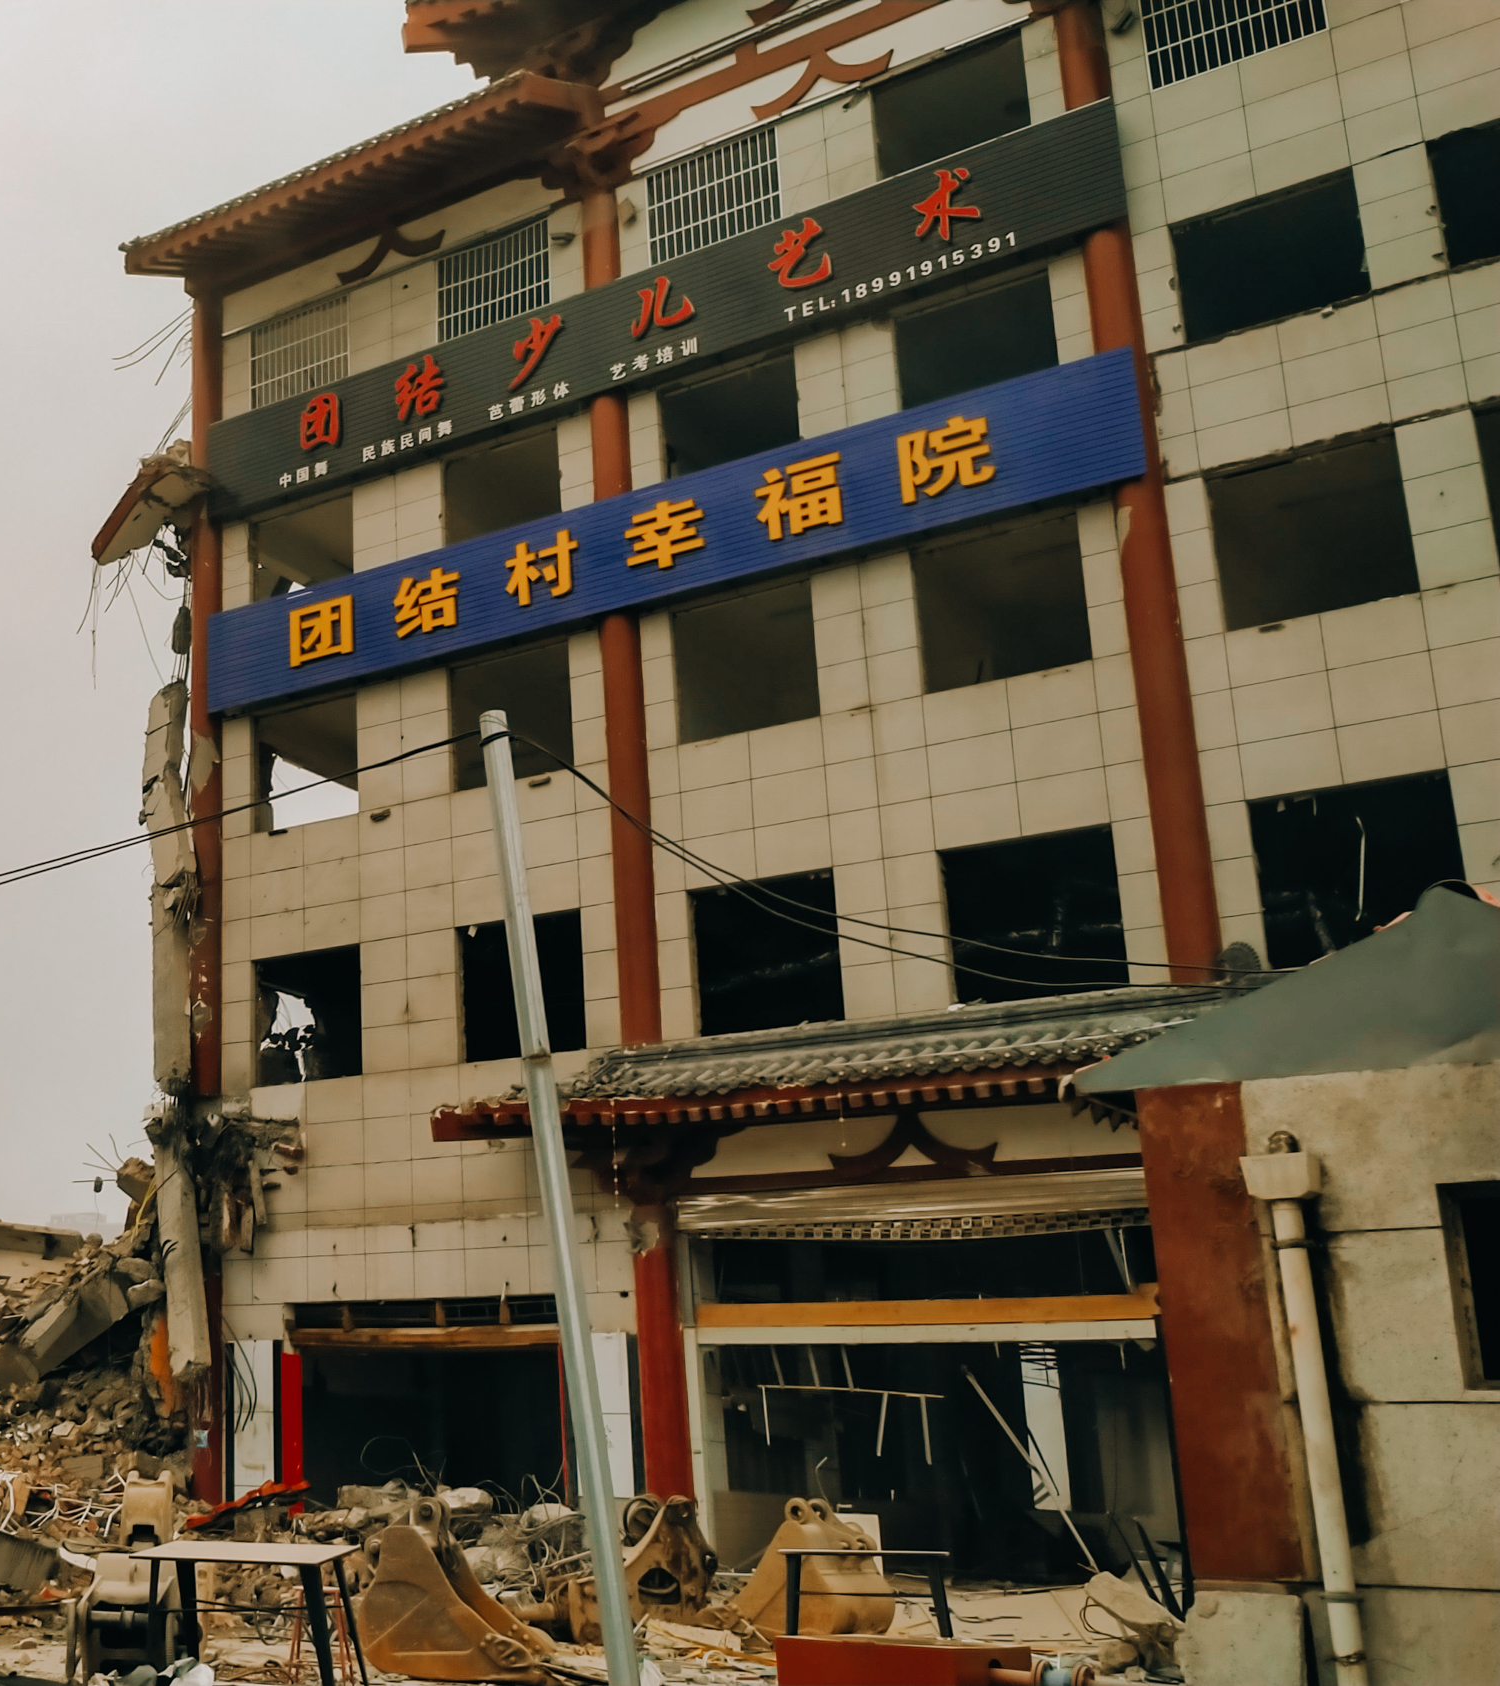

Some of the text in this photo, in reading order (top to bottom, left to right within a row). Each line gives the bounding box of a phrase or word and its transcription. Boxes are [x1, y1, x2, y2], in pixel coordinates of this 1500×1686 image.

[278, 337, 698, 489] 中国舞 民族民间舞 芭蕾形体 艺考培训
[300, 167, 981, 451] 团结少儿艺术
[289, 416, 996, 668] 团结村幸福院
